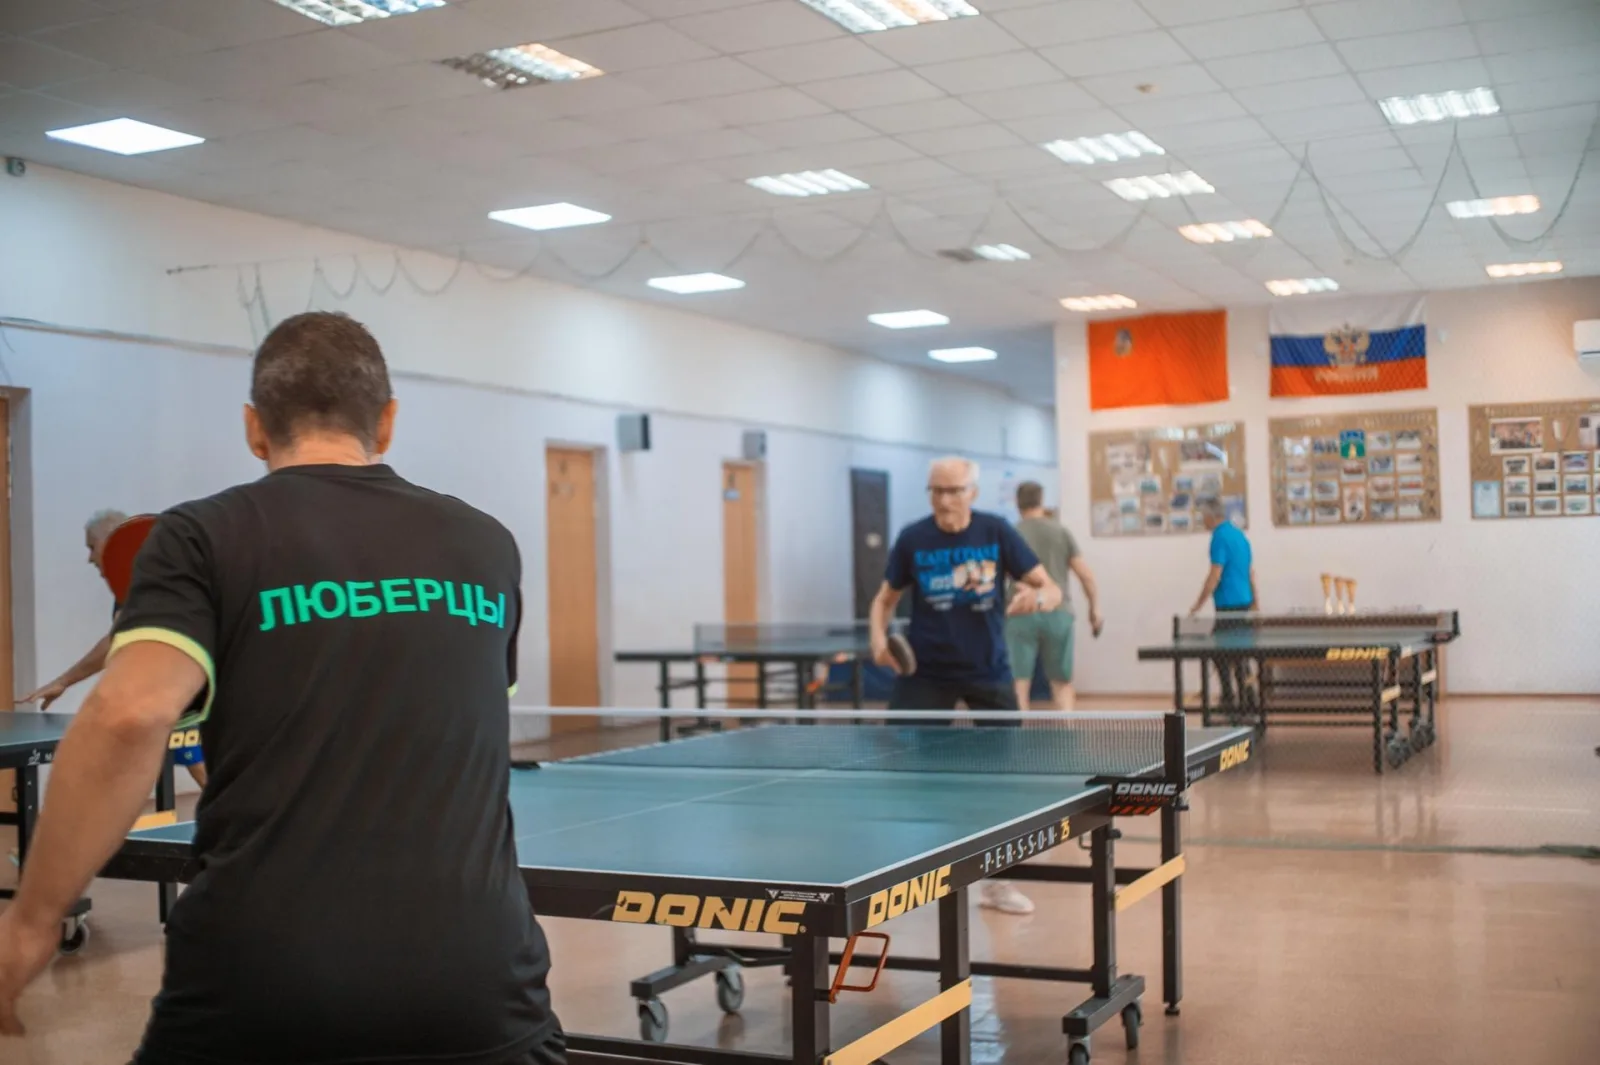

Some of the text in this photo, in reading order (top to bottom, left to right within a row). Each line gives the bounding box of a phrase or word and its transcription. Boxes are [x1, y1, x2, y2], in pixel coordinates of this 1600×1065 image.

[259, 578, 506, 631] ЛЮБЕРЦЫ
[1219, 738, 1250, 772] DONIC
[1115, 782, 1177, 796] DONIC
[612, 890, 806, 935] DONIC
[866, 863, 952, 930] DONIC
